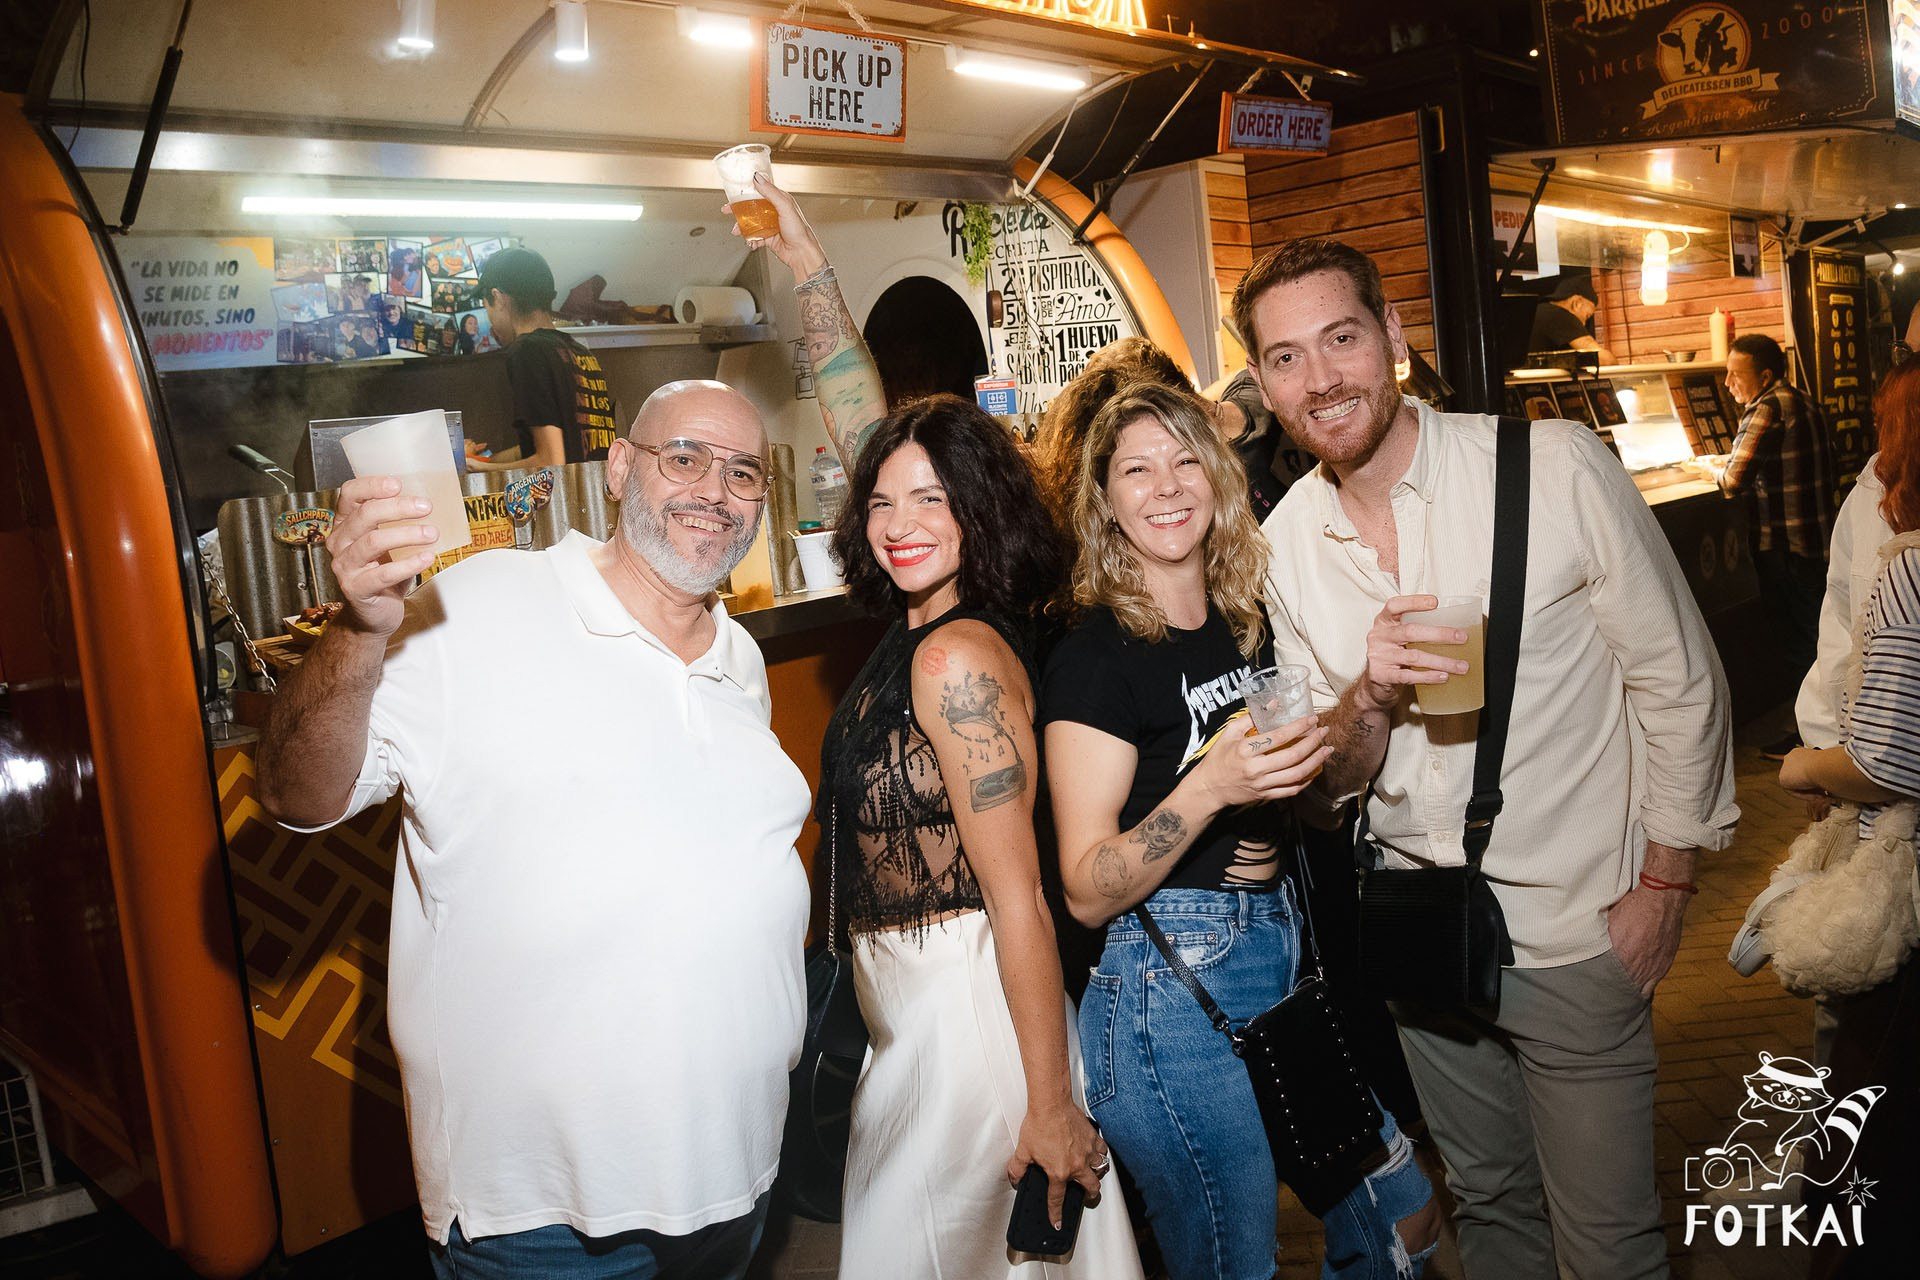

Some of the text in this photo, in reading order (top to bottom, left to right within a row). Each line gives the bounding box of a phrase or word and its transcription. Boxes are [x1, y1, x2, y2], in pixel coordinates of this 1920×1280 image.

[1585, 0, 1671, 24] PARR
[1761, 6, 1834, 40] 2000
[782, 42, 892, 89] PICK UP
[1661, 78, 1731, 101] DELICATESSEN
[809, 85, 865, 124] HERE
[1237, 111, 1324, 141] ORDER HERE
[942, 201, 1055, 262] Rceta
[1494, 210, 1526, 229] PEDI
[988, 239, 1050, 261] ECRETA
[168, 260, 208, 278] VIDA
[214, 259, 240, 277] NO
[143, 285, 240, 303] SE MIDE EN
[141, 308, 256, 328] INUTOS, SINO
[1054, 292, 1116, 323] Amor
[1068, 324, 1119, 349] HUEVO
[510, 471, 547, 495] ARGENTINO
[464, 496, 509, 522] NING
[489, 529, 513, 545] AREA
